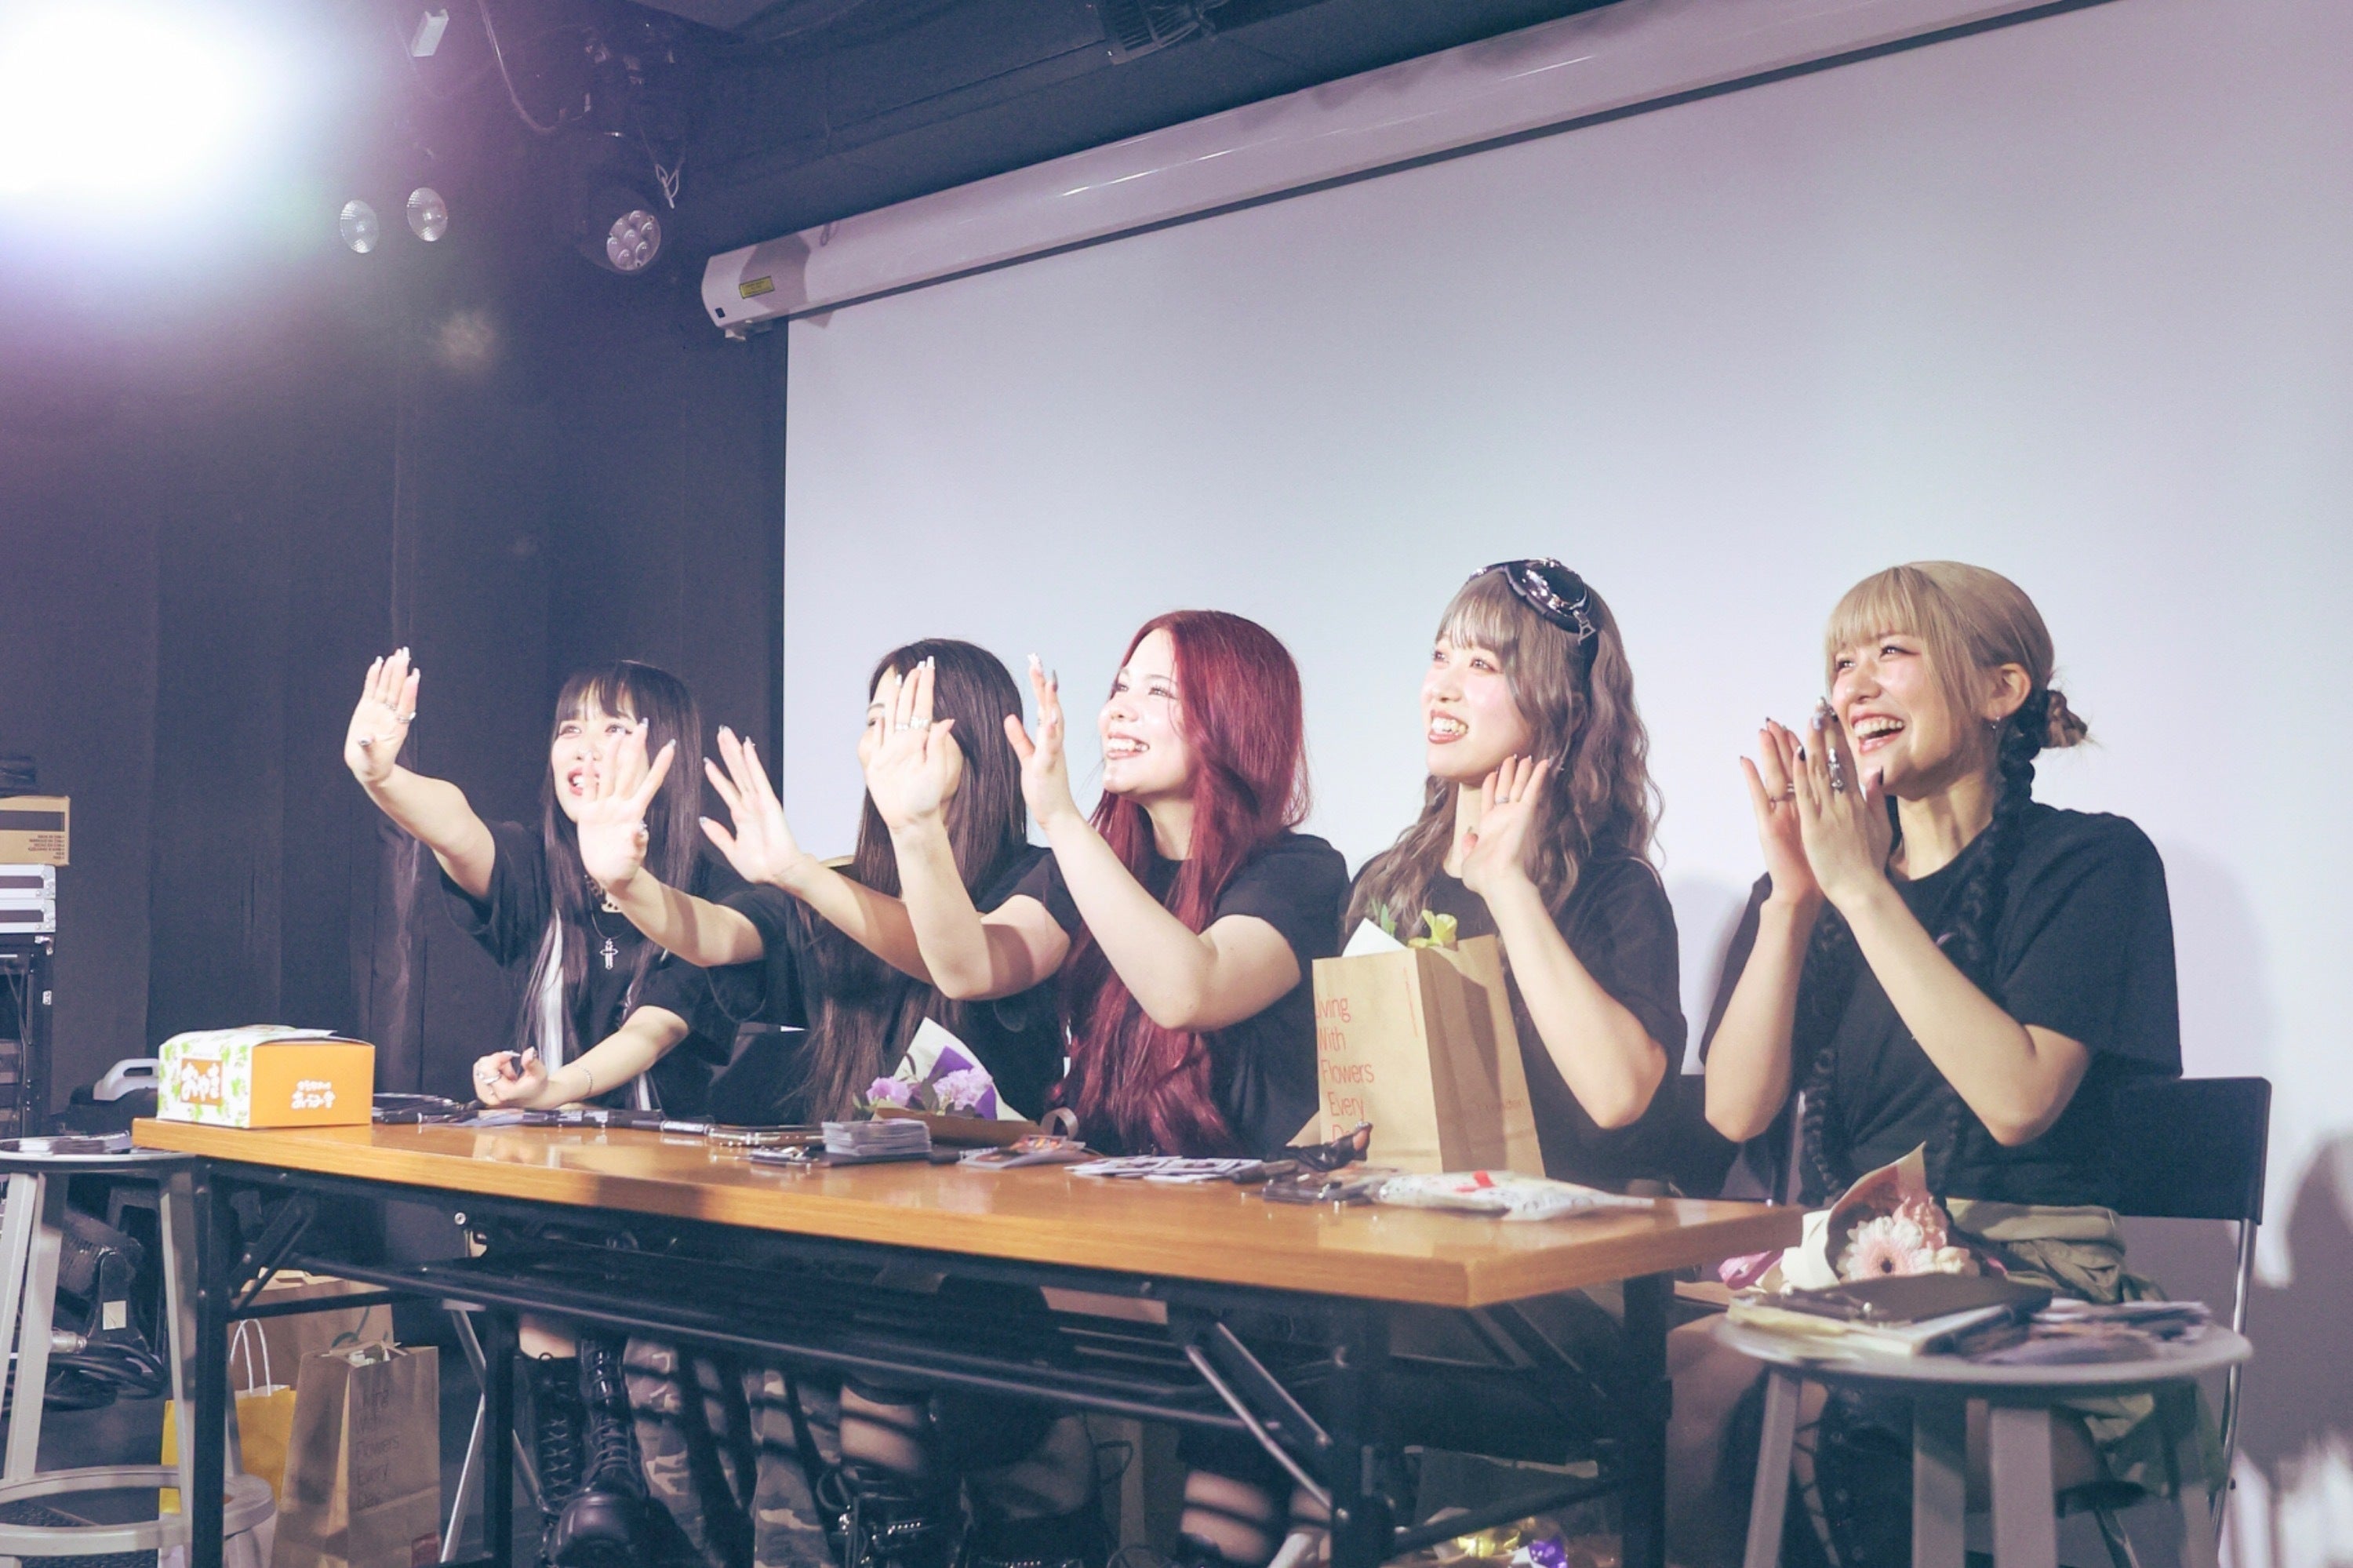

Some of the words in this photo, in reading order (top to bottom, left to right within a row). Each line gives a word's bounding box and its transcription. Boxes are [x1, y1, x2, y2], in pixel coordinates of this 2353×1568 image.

[1318, 1028, 1347, 1052] With
[1321, 1059, 1375, 1084] Flowers
[1327, 1091, 1365, 1122] Every
